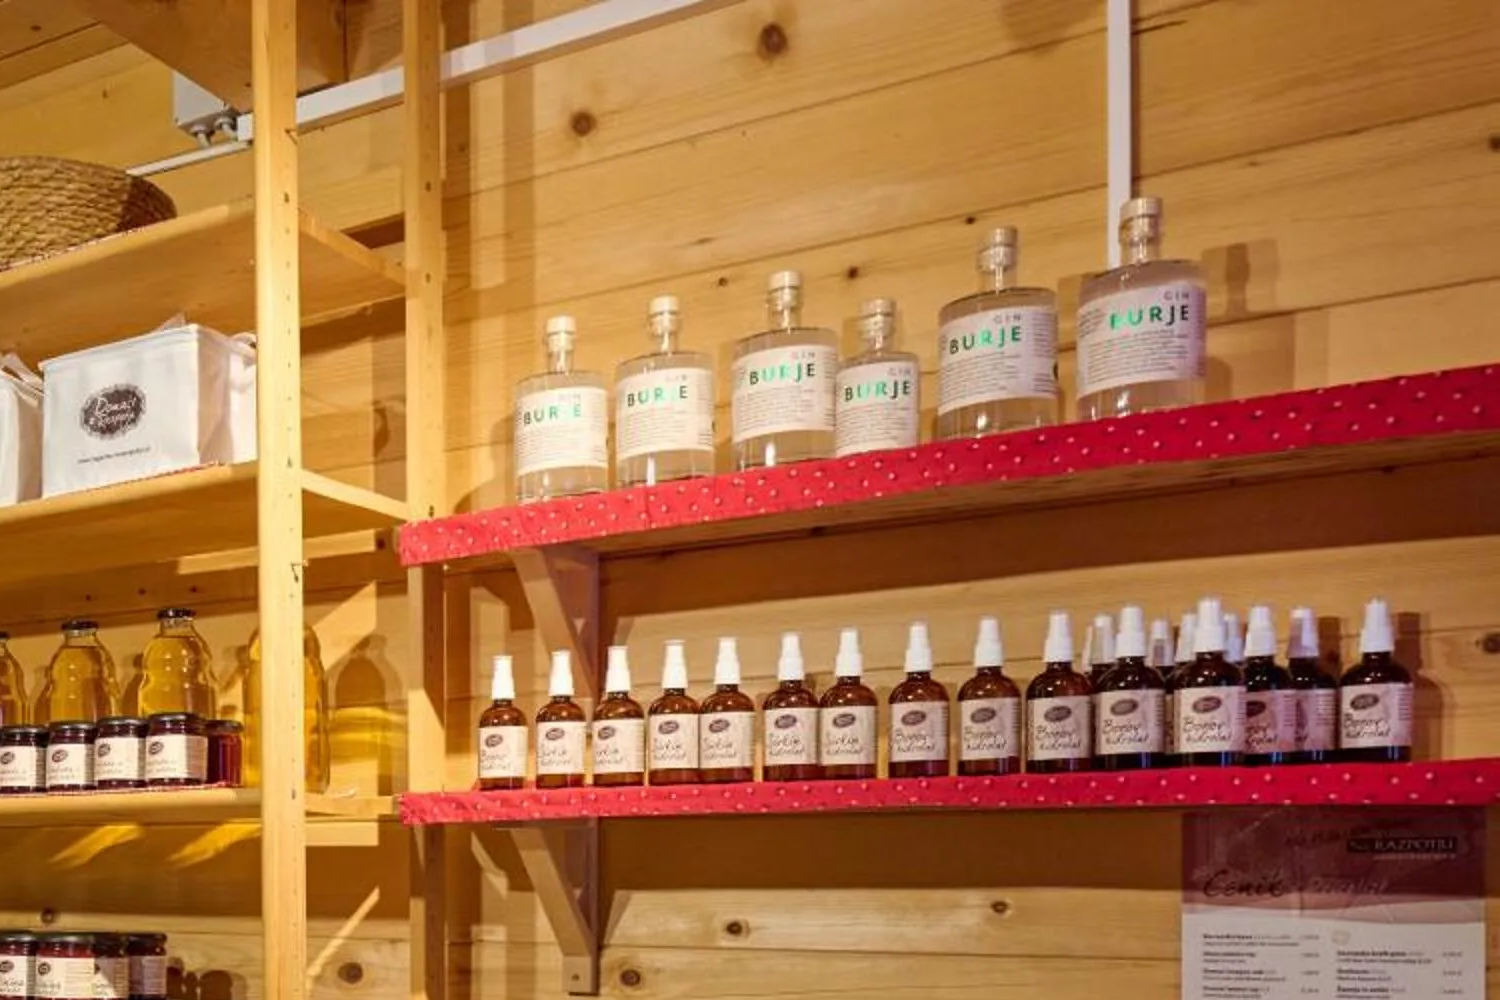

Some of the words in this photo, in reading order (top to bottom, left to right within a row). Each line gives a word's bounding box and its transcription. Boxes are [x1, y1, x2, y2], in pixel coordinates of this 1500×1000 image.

[949, 325, 1022, 355] BURJE
[627, 384, 688, 408] BURE
[845, 380, 912, 403] BURJE
[523, 402, 582, 425] BURE
